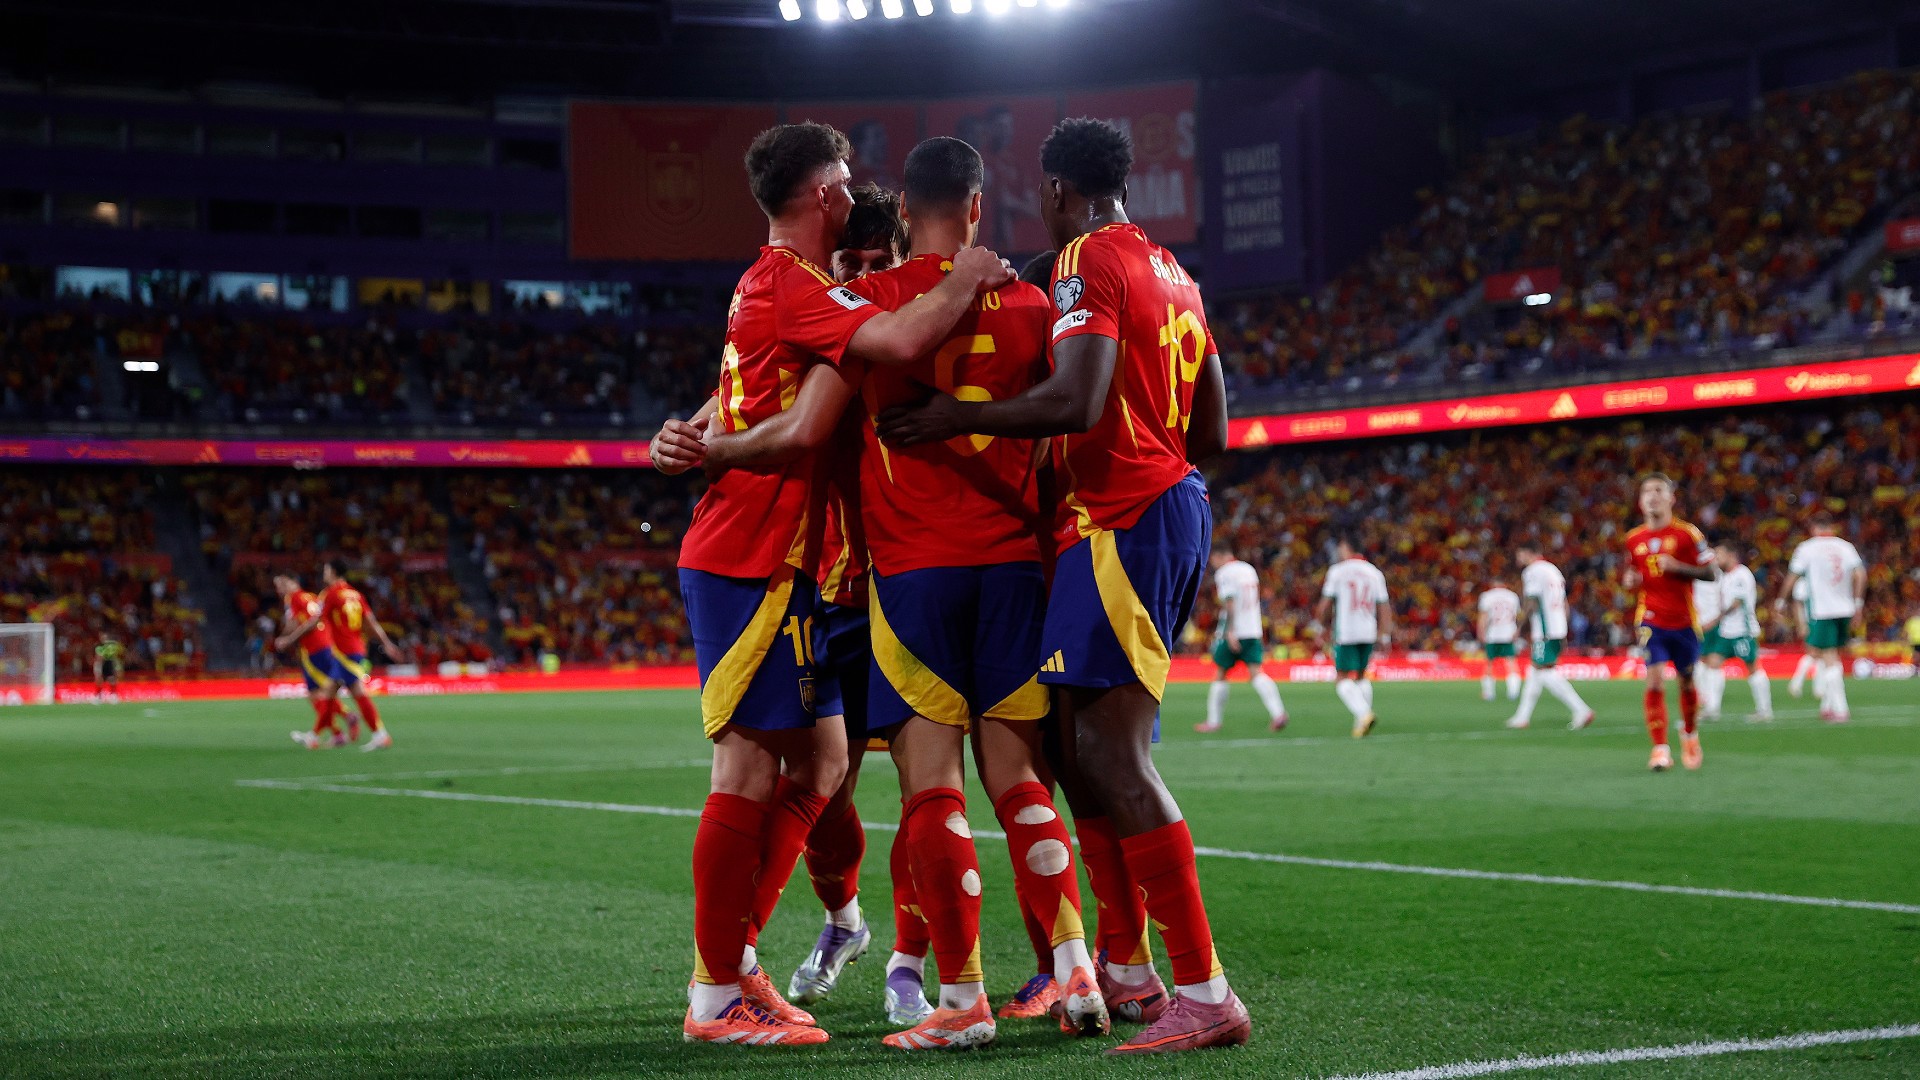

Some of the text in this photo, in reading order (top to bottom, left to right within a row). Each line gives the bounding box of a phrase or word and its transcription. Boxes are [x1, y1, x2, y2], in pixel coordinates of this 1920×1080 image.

[935, 334, 996, 457] 6
[1159, 303, 1206, 433] 19
[1347, 579, 1374, 610] 14
[782, 615, 815, 667] 10
